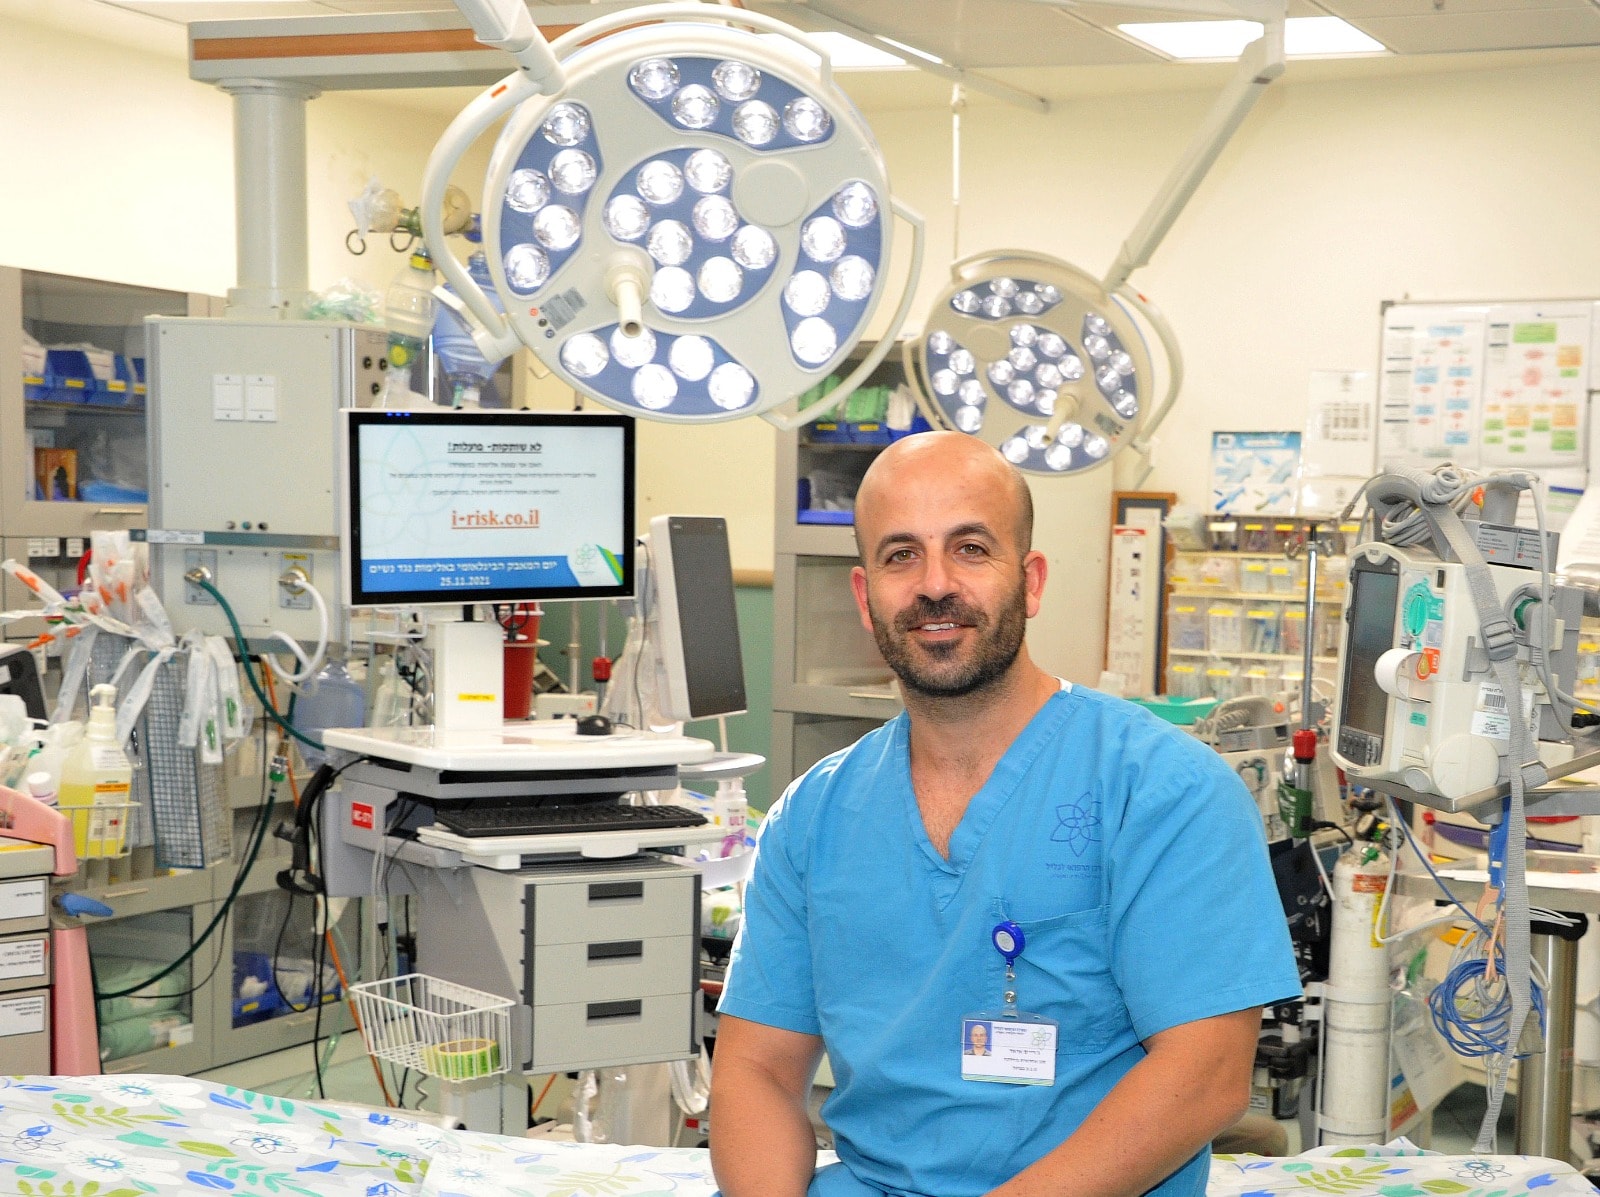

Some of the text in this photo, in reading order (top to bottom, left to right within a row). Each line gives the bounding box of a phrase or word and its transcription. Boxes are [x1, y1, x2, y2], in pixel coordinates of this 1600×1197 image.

[529, 441, 542, 452] לא
[452, 510, 539, 526] i-risk.co.il
[542, 561, 557, 570] יום
[440, 576, 491, 587] 25.11.2021
